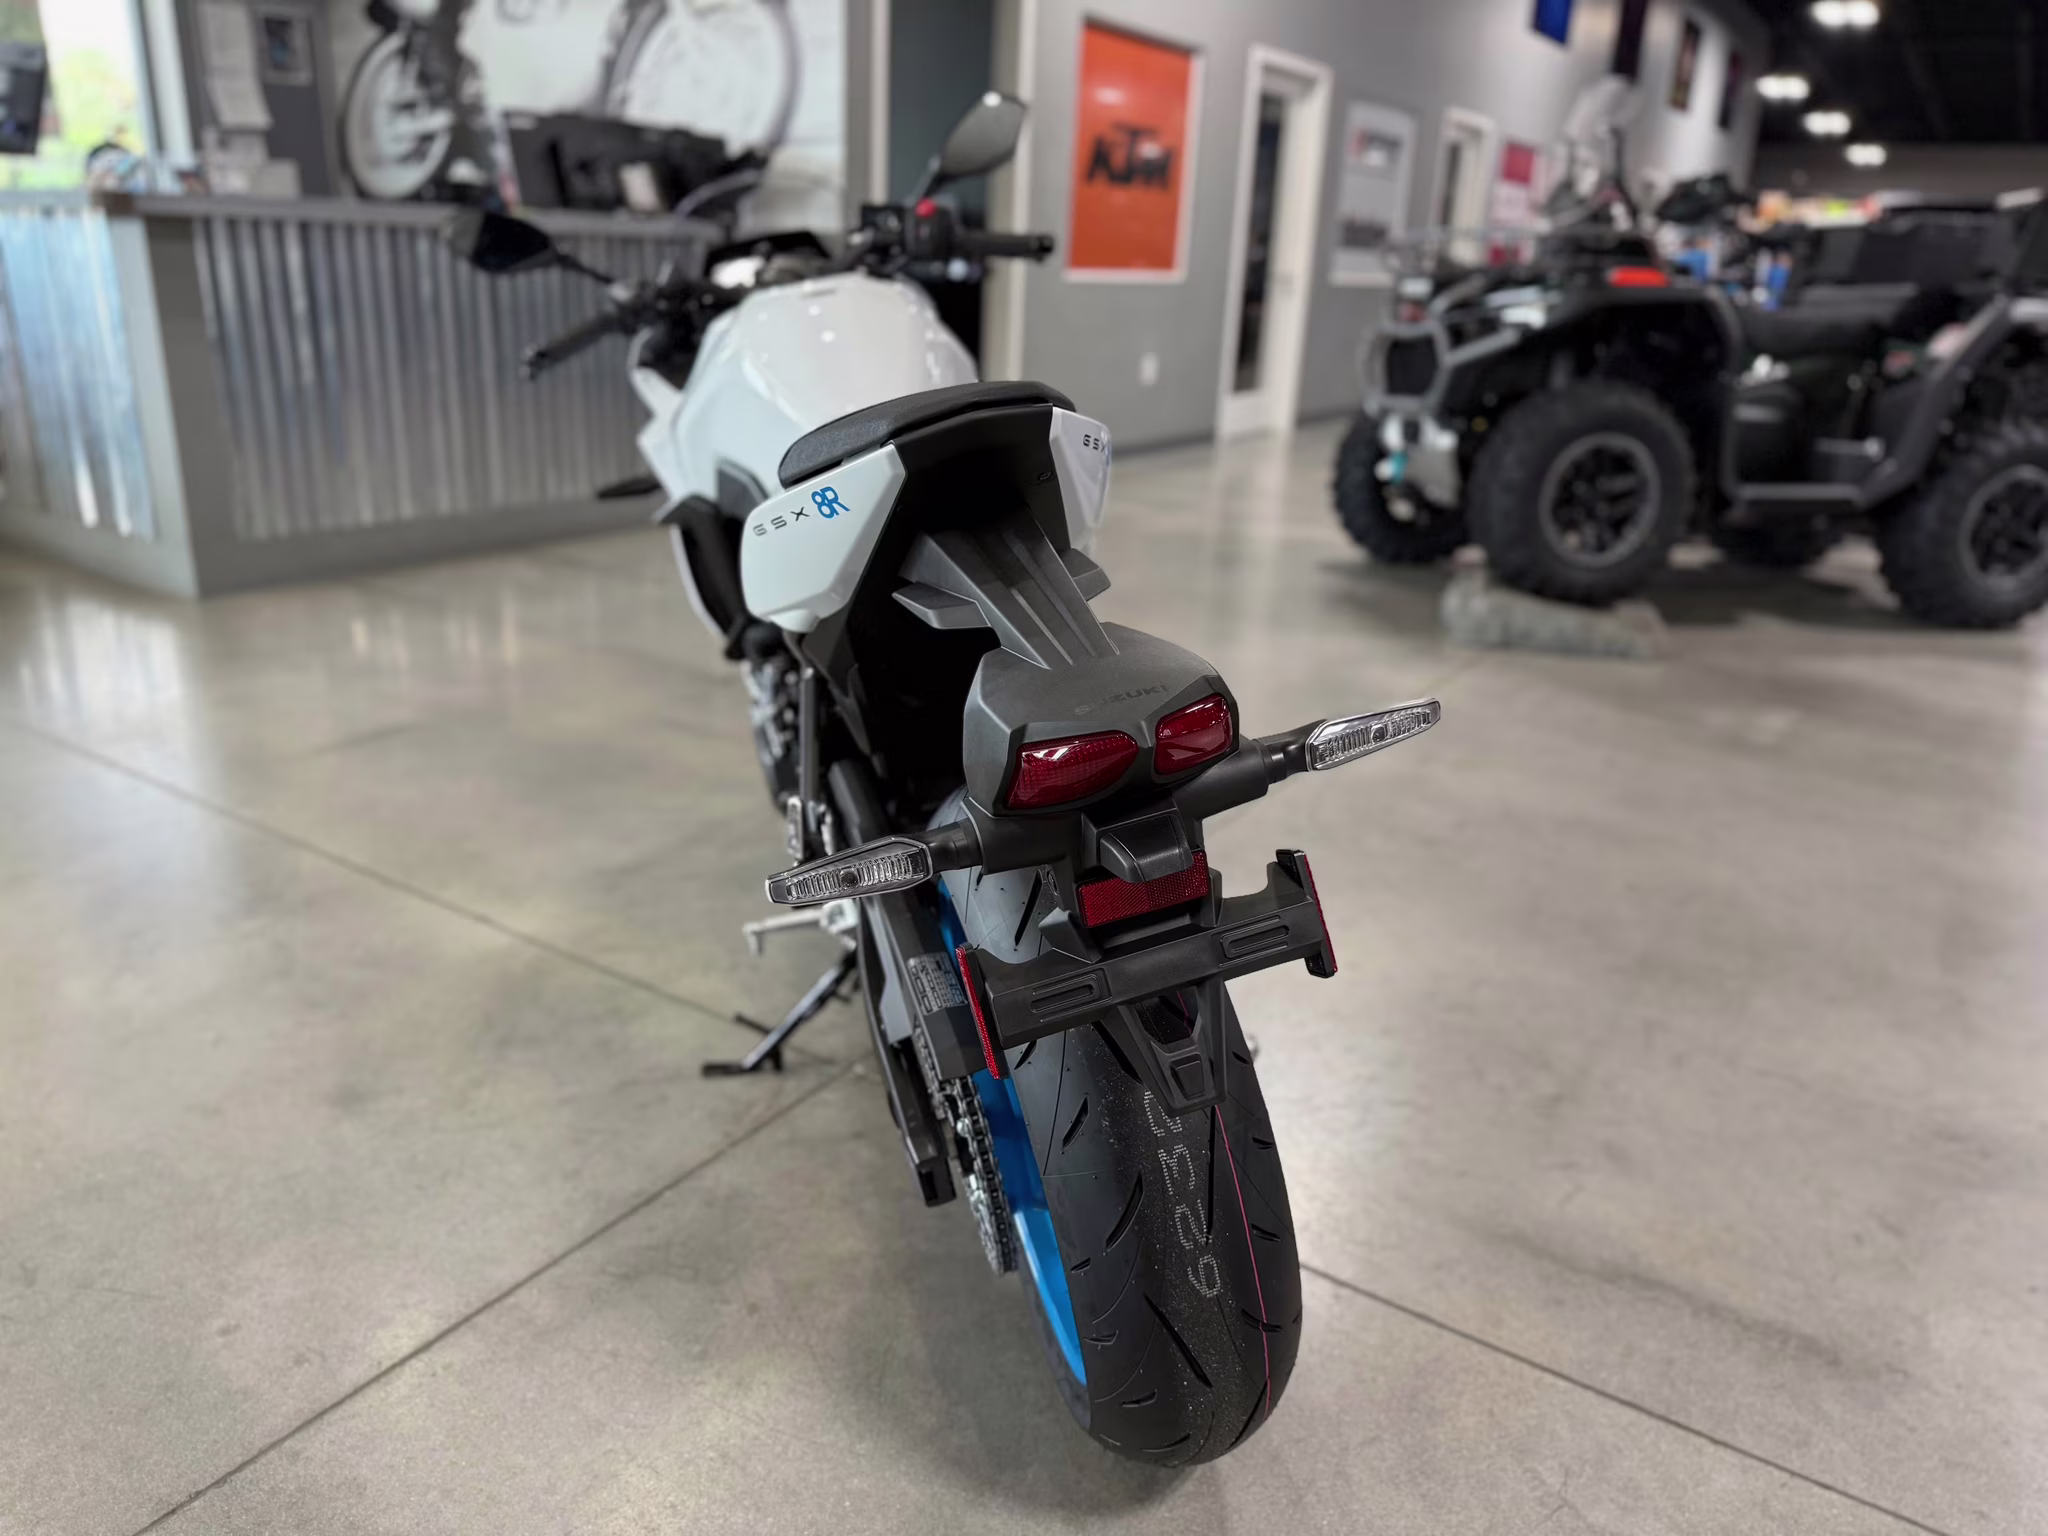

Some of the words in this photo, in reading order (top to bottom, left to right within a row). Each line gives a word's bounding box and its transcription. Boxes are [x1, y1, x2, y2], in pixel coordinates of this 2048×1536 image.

[753, 506, 810, 536] GSX
[811, 486, 850, 519] 8R
[1074, 685, 1168, 715] SUZUKI
